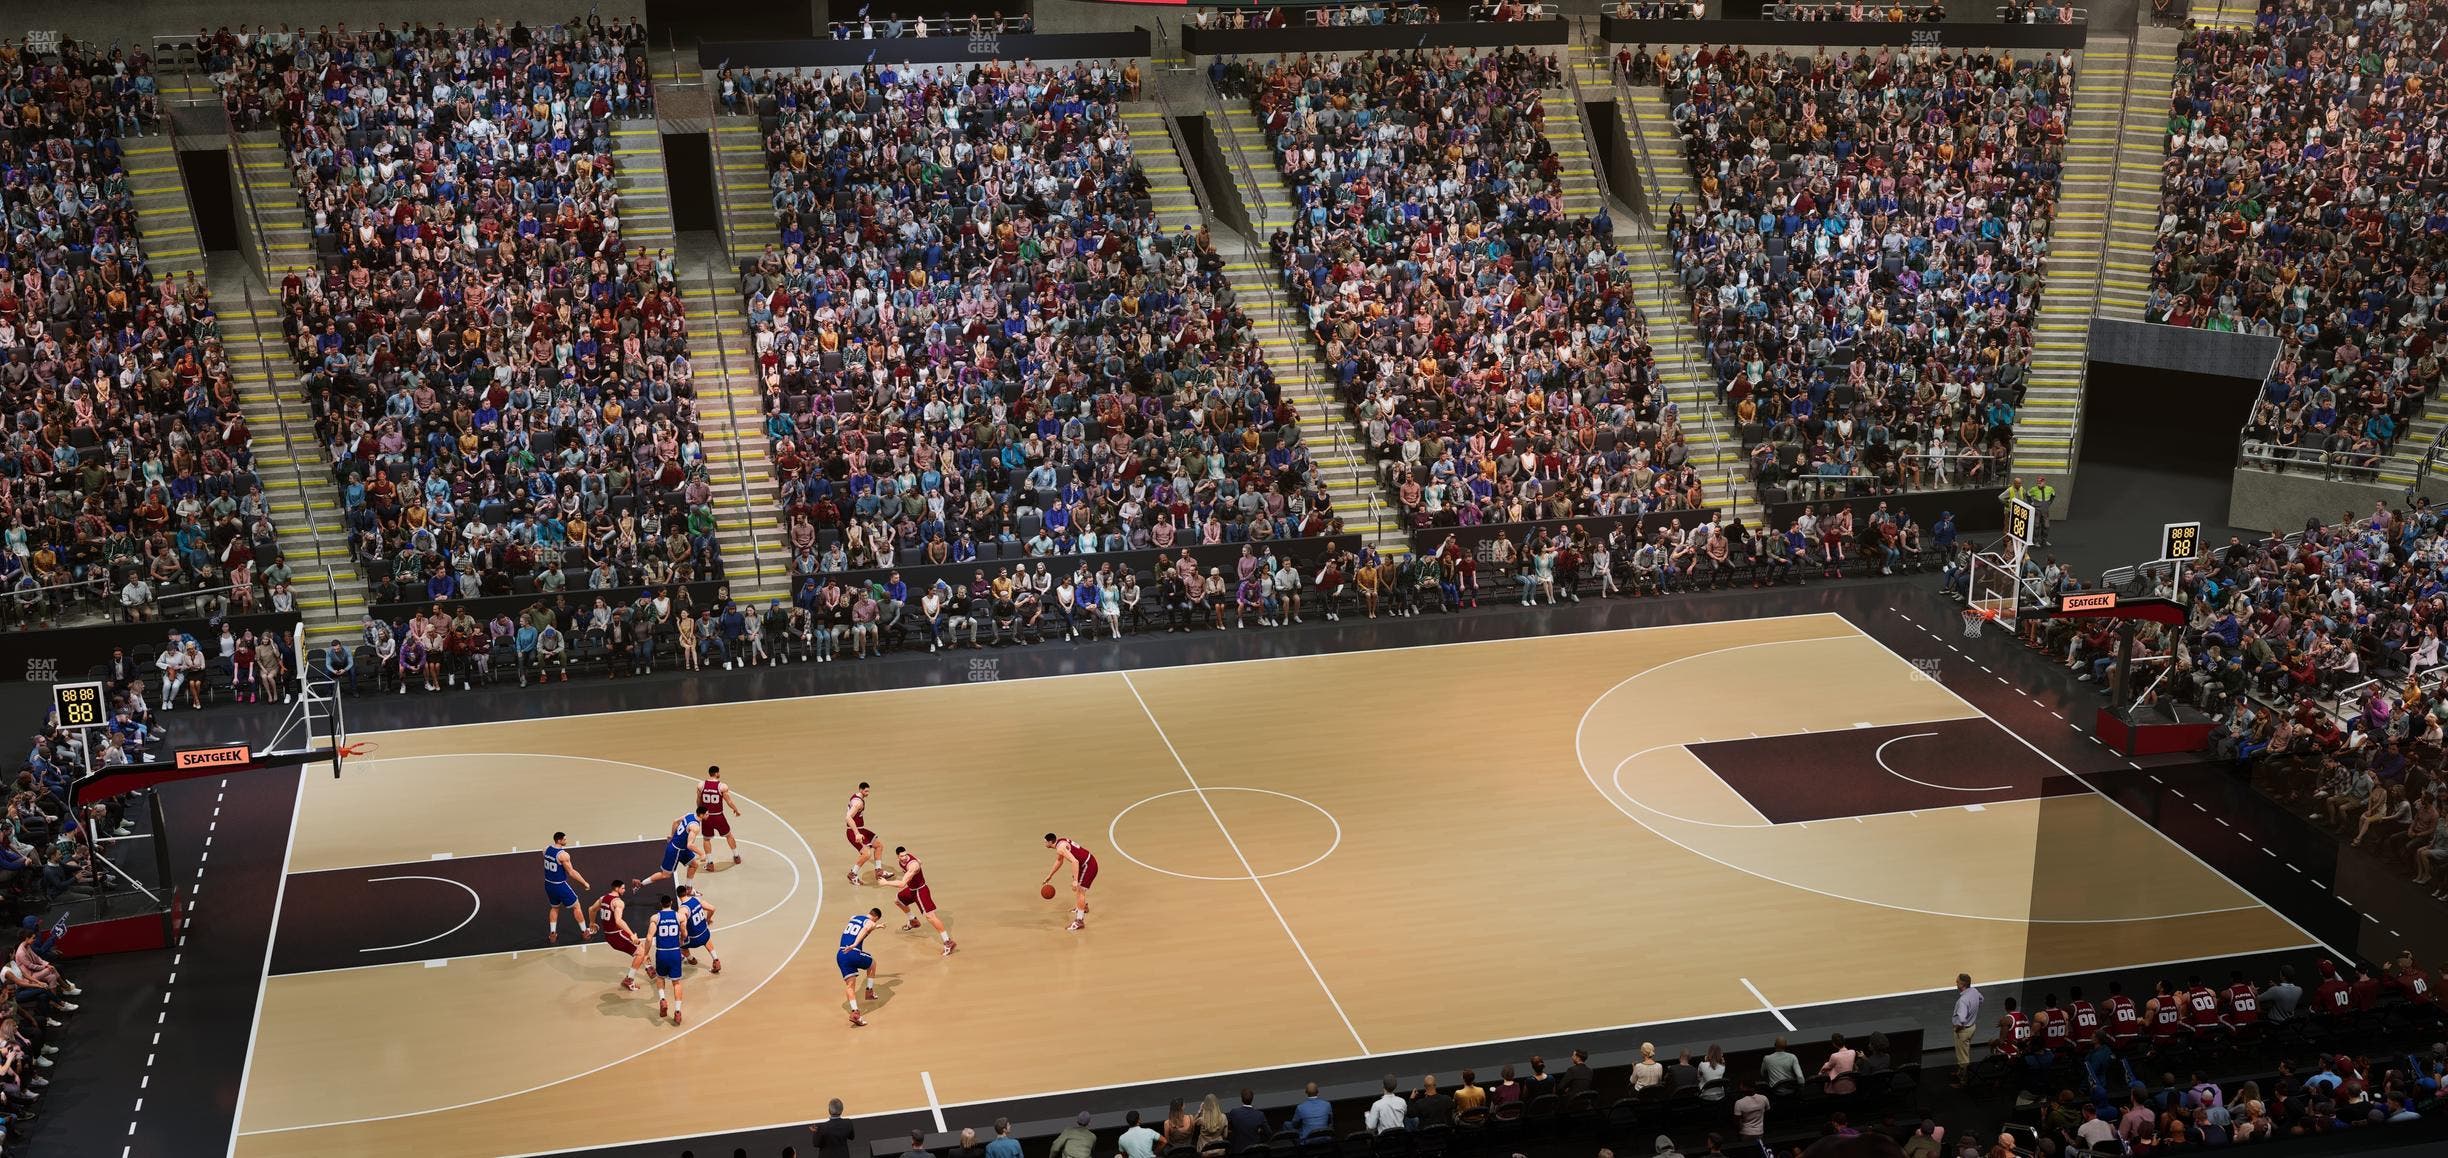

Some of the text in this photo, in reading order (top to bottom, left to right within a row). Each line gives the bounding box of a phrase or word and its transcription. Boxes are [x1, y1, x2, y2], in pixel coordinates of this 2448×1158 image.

[2013, 504, 2028, 520] 88 88
[2013, 518, 2025, 537] 88
[2172, 527, 2195, 539] 88 88
[2173, 539, 2191, 557] 88
[2069, 596, 2111, 608] SEATGEEK
[62, 688, 95, 702] 88 88
[68, 703, 94, 723] 88
[183, 751, 242, 765] SEATGEEK
[702, 794, 720, 804] 00
[544, 860, 558, 873] 00
[692, 908, 705, 926] 00
[659, 925, 679, 937] 00
[843, 922, 861, 936] 00
[2192, 996, 2215, 1011] 00
[2334, 990, 2348, 1006] 00
[2234, 999, 2256, 1012] 00
[2078, 1013, 2097, 1026] 00
[2117, 1009, 2136, 1021] 00
[2159, 1011, 2177, 1024] 00
[2015, 1026, 2031, 1039] 00
[2047, 1025, 2066, 1037] 00
